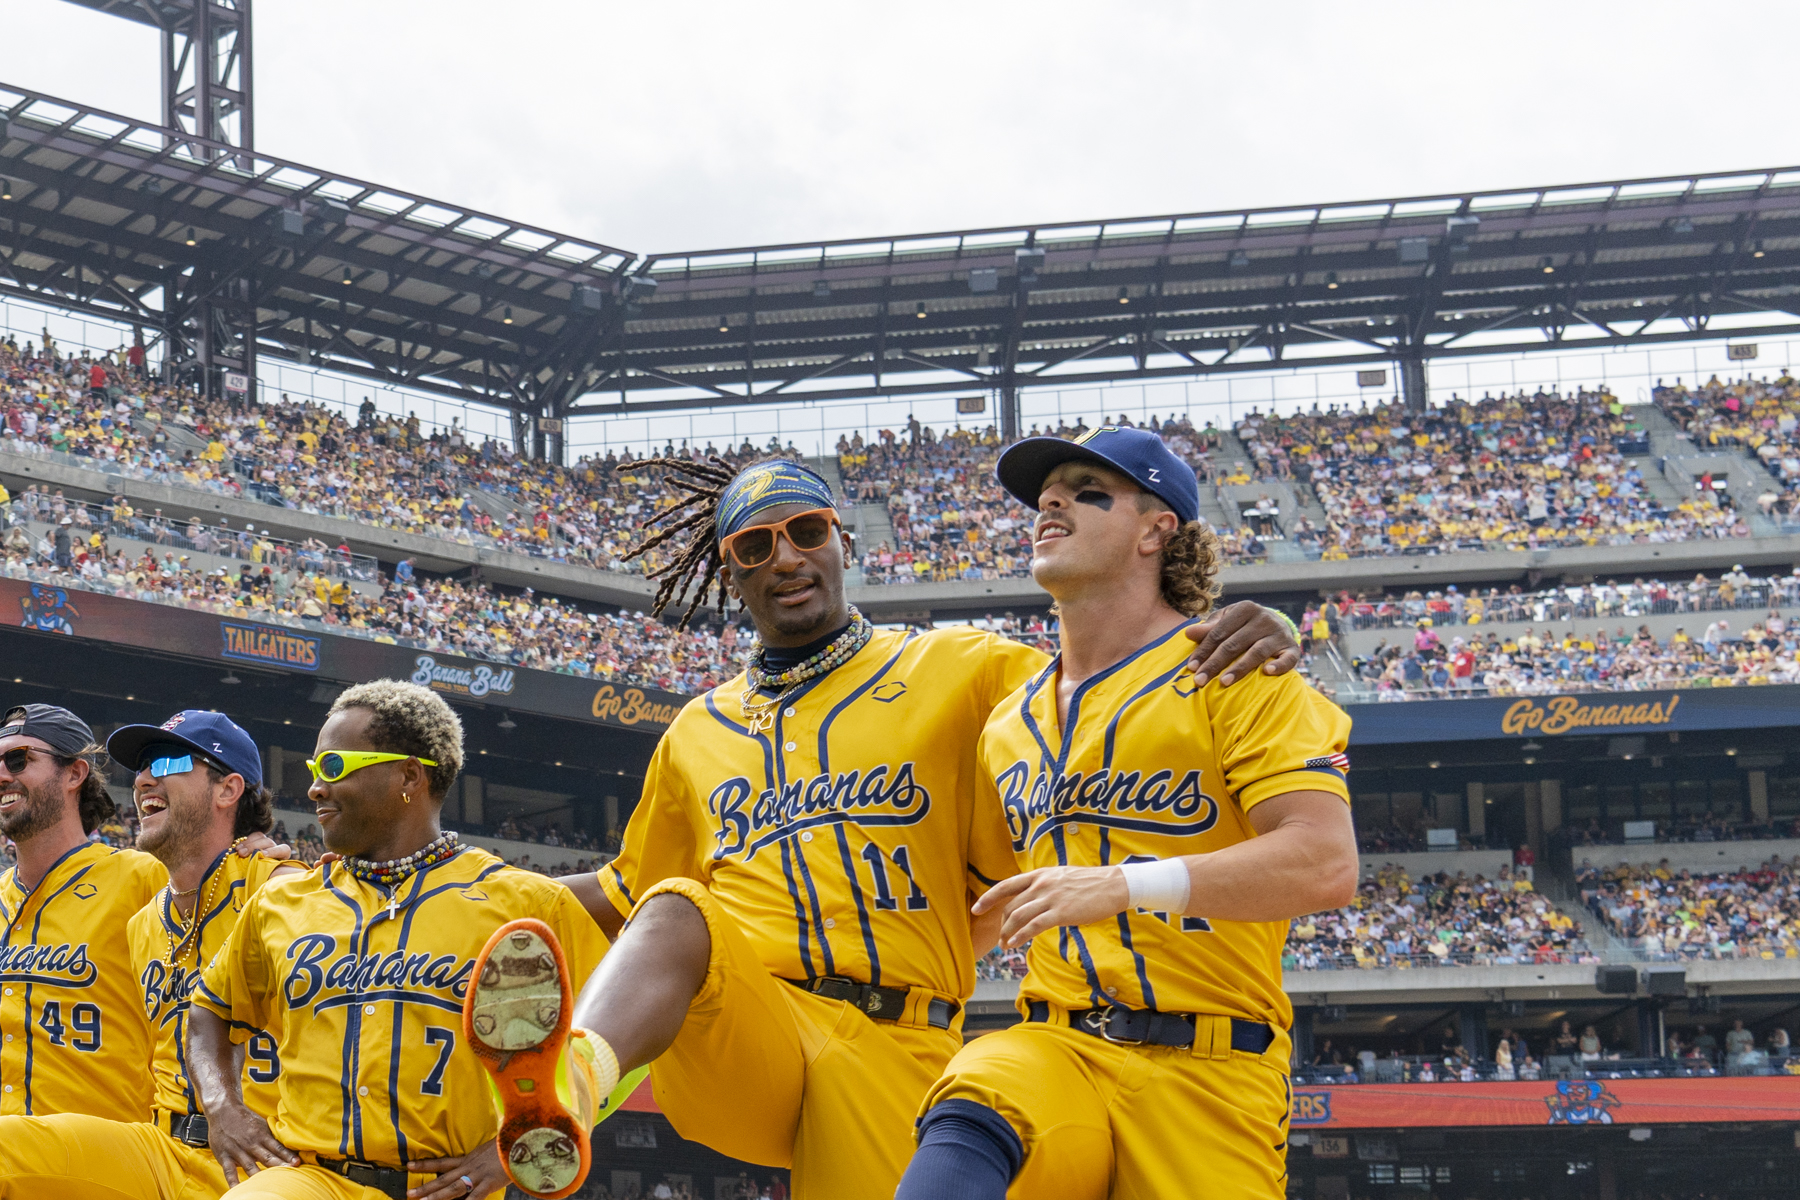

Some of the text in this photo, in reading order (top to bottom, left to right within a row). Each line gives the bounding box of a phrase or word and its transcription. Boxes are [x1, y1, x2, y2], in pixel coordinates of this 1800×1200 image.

[225, 627, 315, 664] TAILGATERS
[412, 655, 516, 697] Banana Ball
[592, 685, 618, 715] Go
[1502, 695, 1680, 734] Go Bananas!
[708, 762, 931, 863] Bananas
[995, 759, 1219, 853] Bananas
[861, 841, 930, 912] 11
[284, 933, 477, 1019] Bananas
[38, 1000, 102, 1052] 49
[419, 1025, 455, 1096] 7
